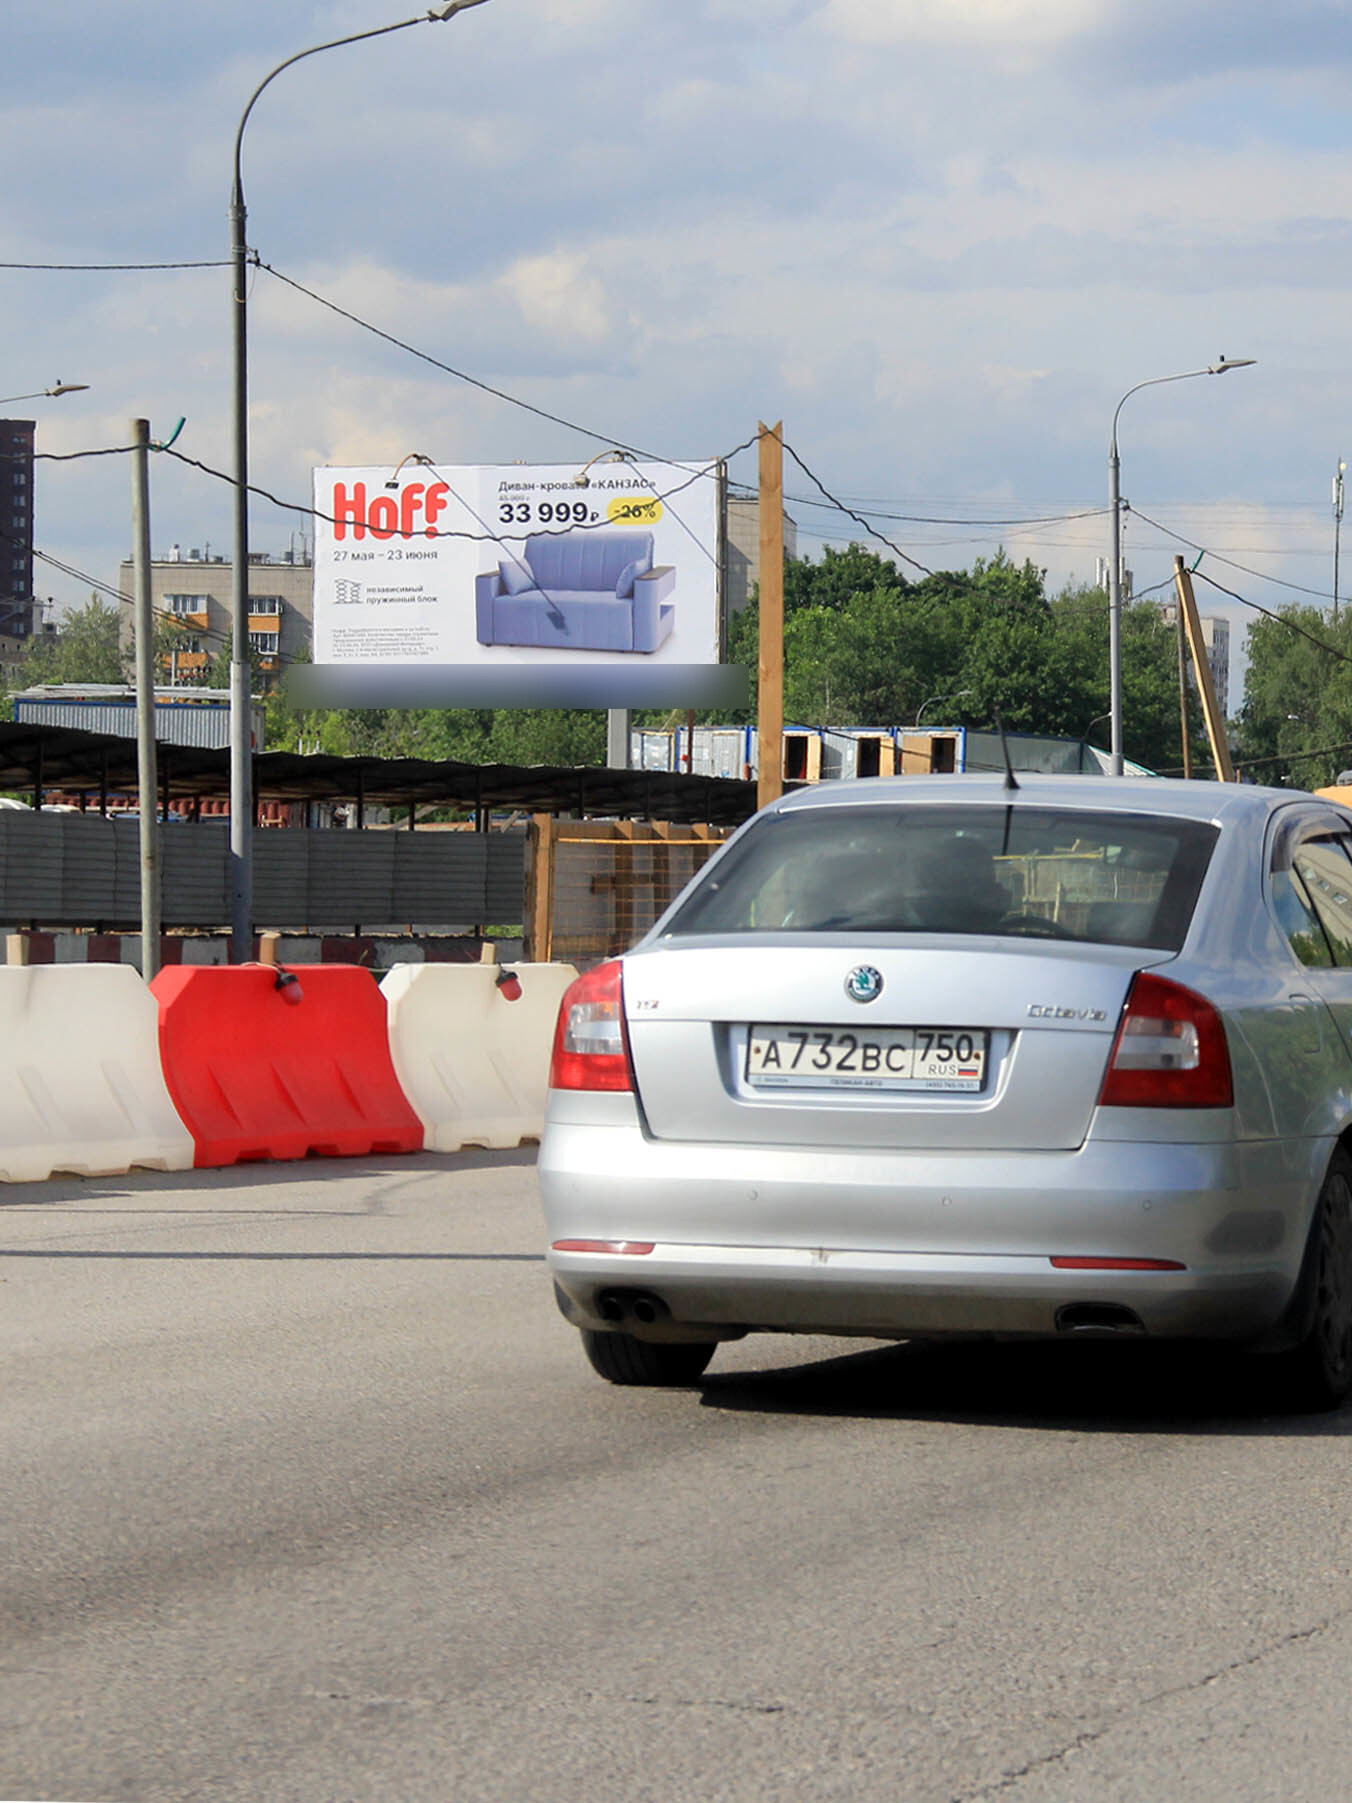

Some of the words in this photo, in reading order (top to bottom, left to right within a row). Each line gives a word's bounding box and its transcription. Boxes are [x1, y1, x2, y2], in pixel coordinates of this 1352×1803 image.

[333, 482, 449, 541] Hoff
[500, 503, 531, 523] 33
[333, 551, 347, 561] 27
[351, 552, 374, 561] мая
[387, 550, 402, 561] 23
[405, 551, 438, 561] июня
[761, 1032, 906, 1072] А732ВС
[918, 1034, 974, 1062] 750
[928, 1064, 957, 1075] RUS
